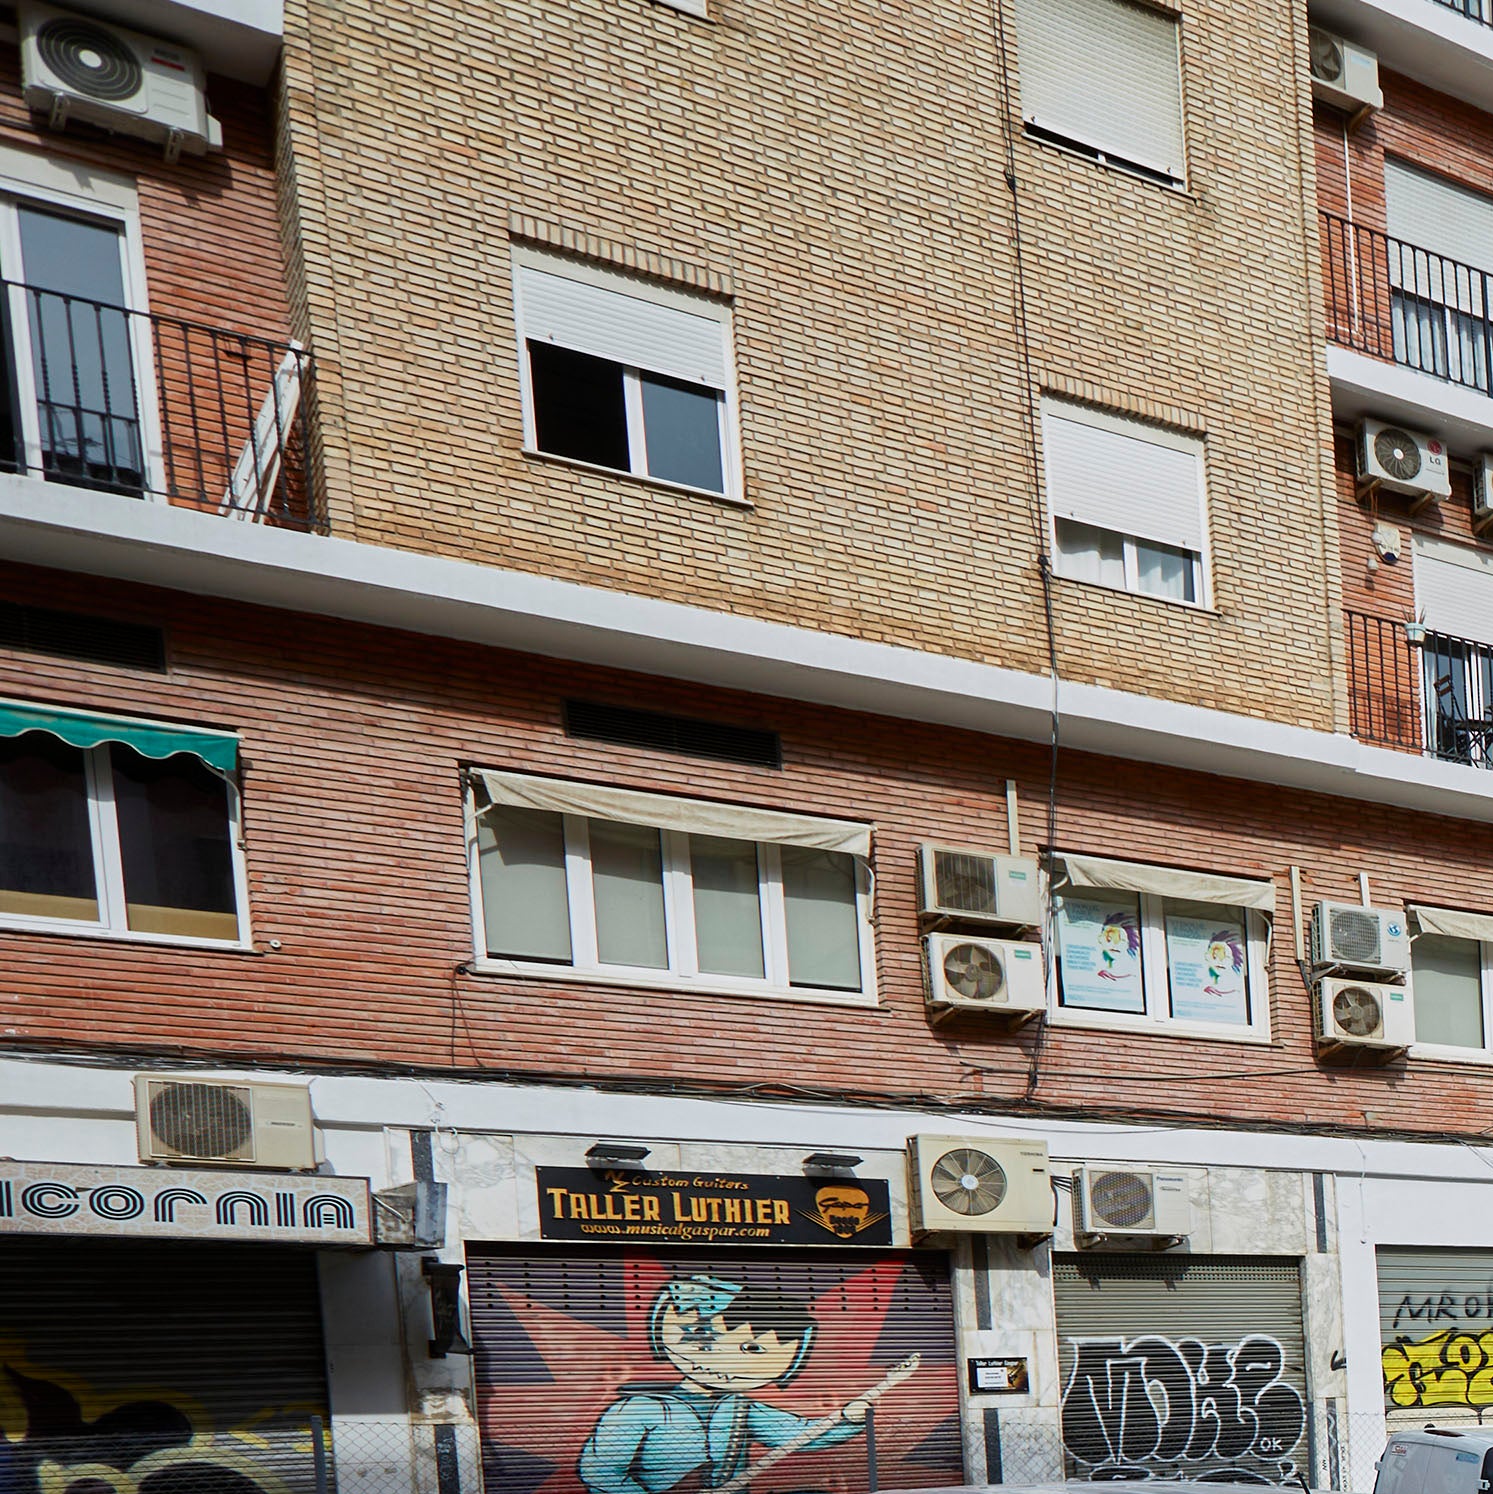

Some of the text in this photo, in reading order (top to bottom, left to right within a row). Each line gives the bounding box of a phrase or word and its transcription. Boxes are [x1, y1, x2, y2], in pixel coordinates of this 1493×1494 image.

[547, 1188, 790, 1224] TALLER LUTHIER
[581, 1224, 770, 1240] www.musicalgaspar.com
[1260, 1437, 1283, 1452] OK
